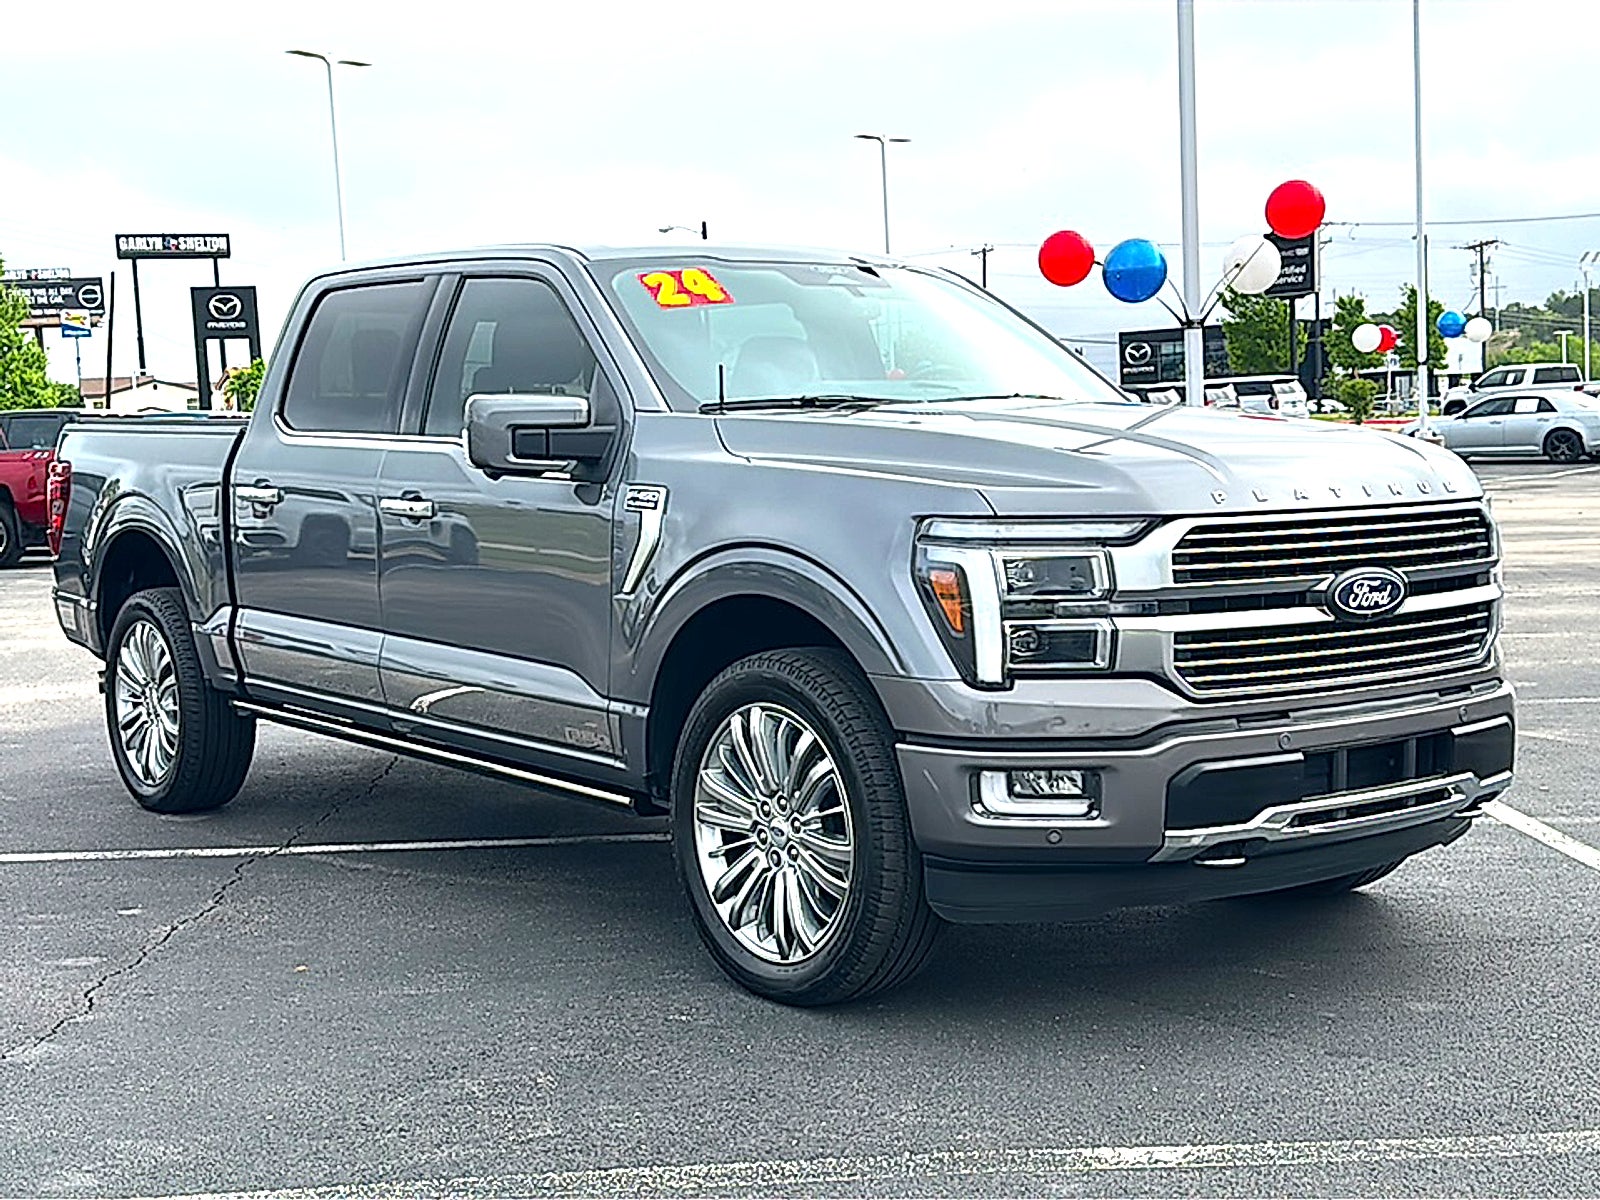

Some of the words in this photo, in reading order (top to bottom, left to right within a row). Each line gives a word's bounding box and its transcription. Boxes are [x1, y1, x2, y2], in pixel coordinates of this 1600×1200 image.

[177, 236, 228, 252] SHELTON
[1281, 263, 1307, 275] rtified
[641, 267, 726, 306] 24
[1349, 580, 1391, 607] Ford
